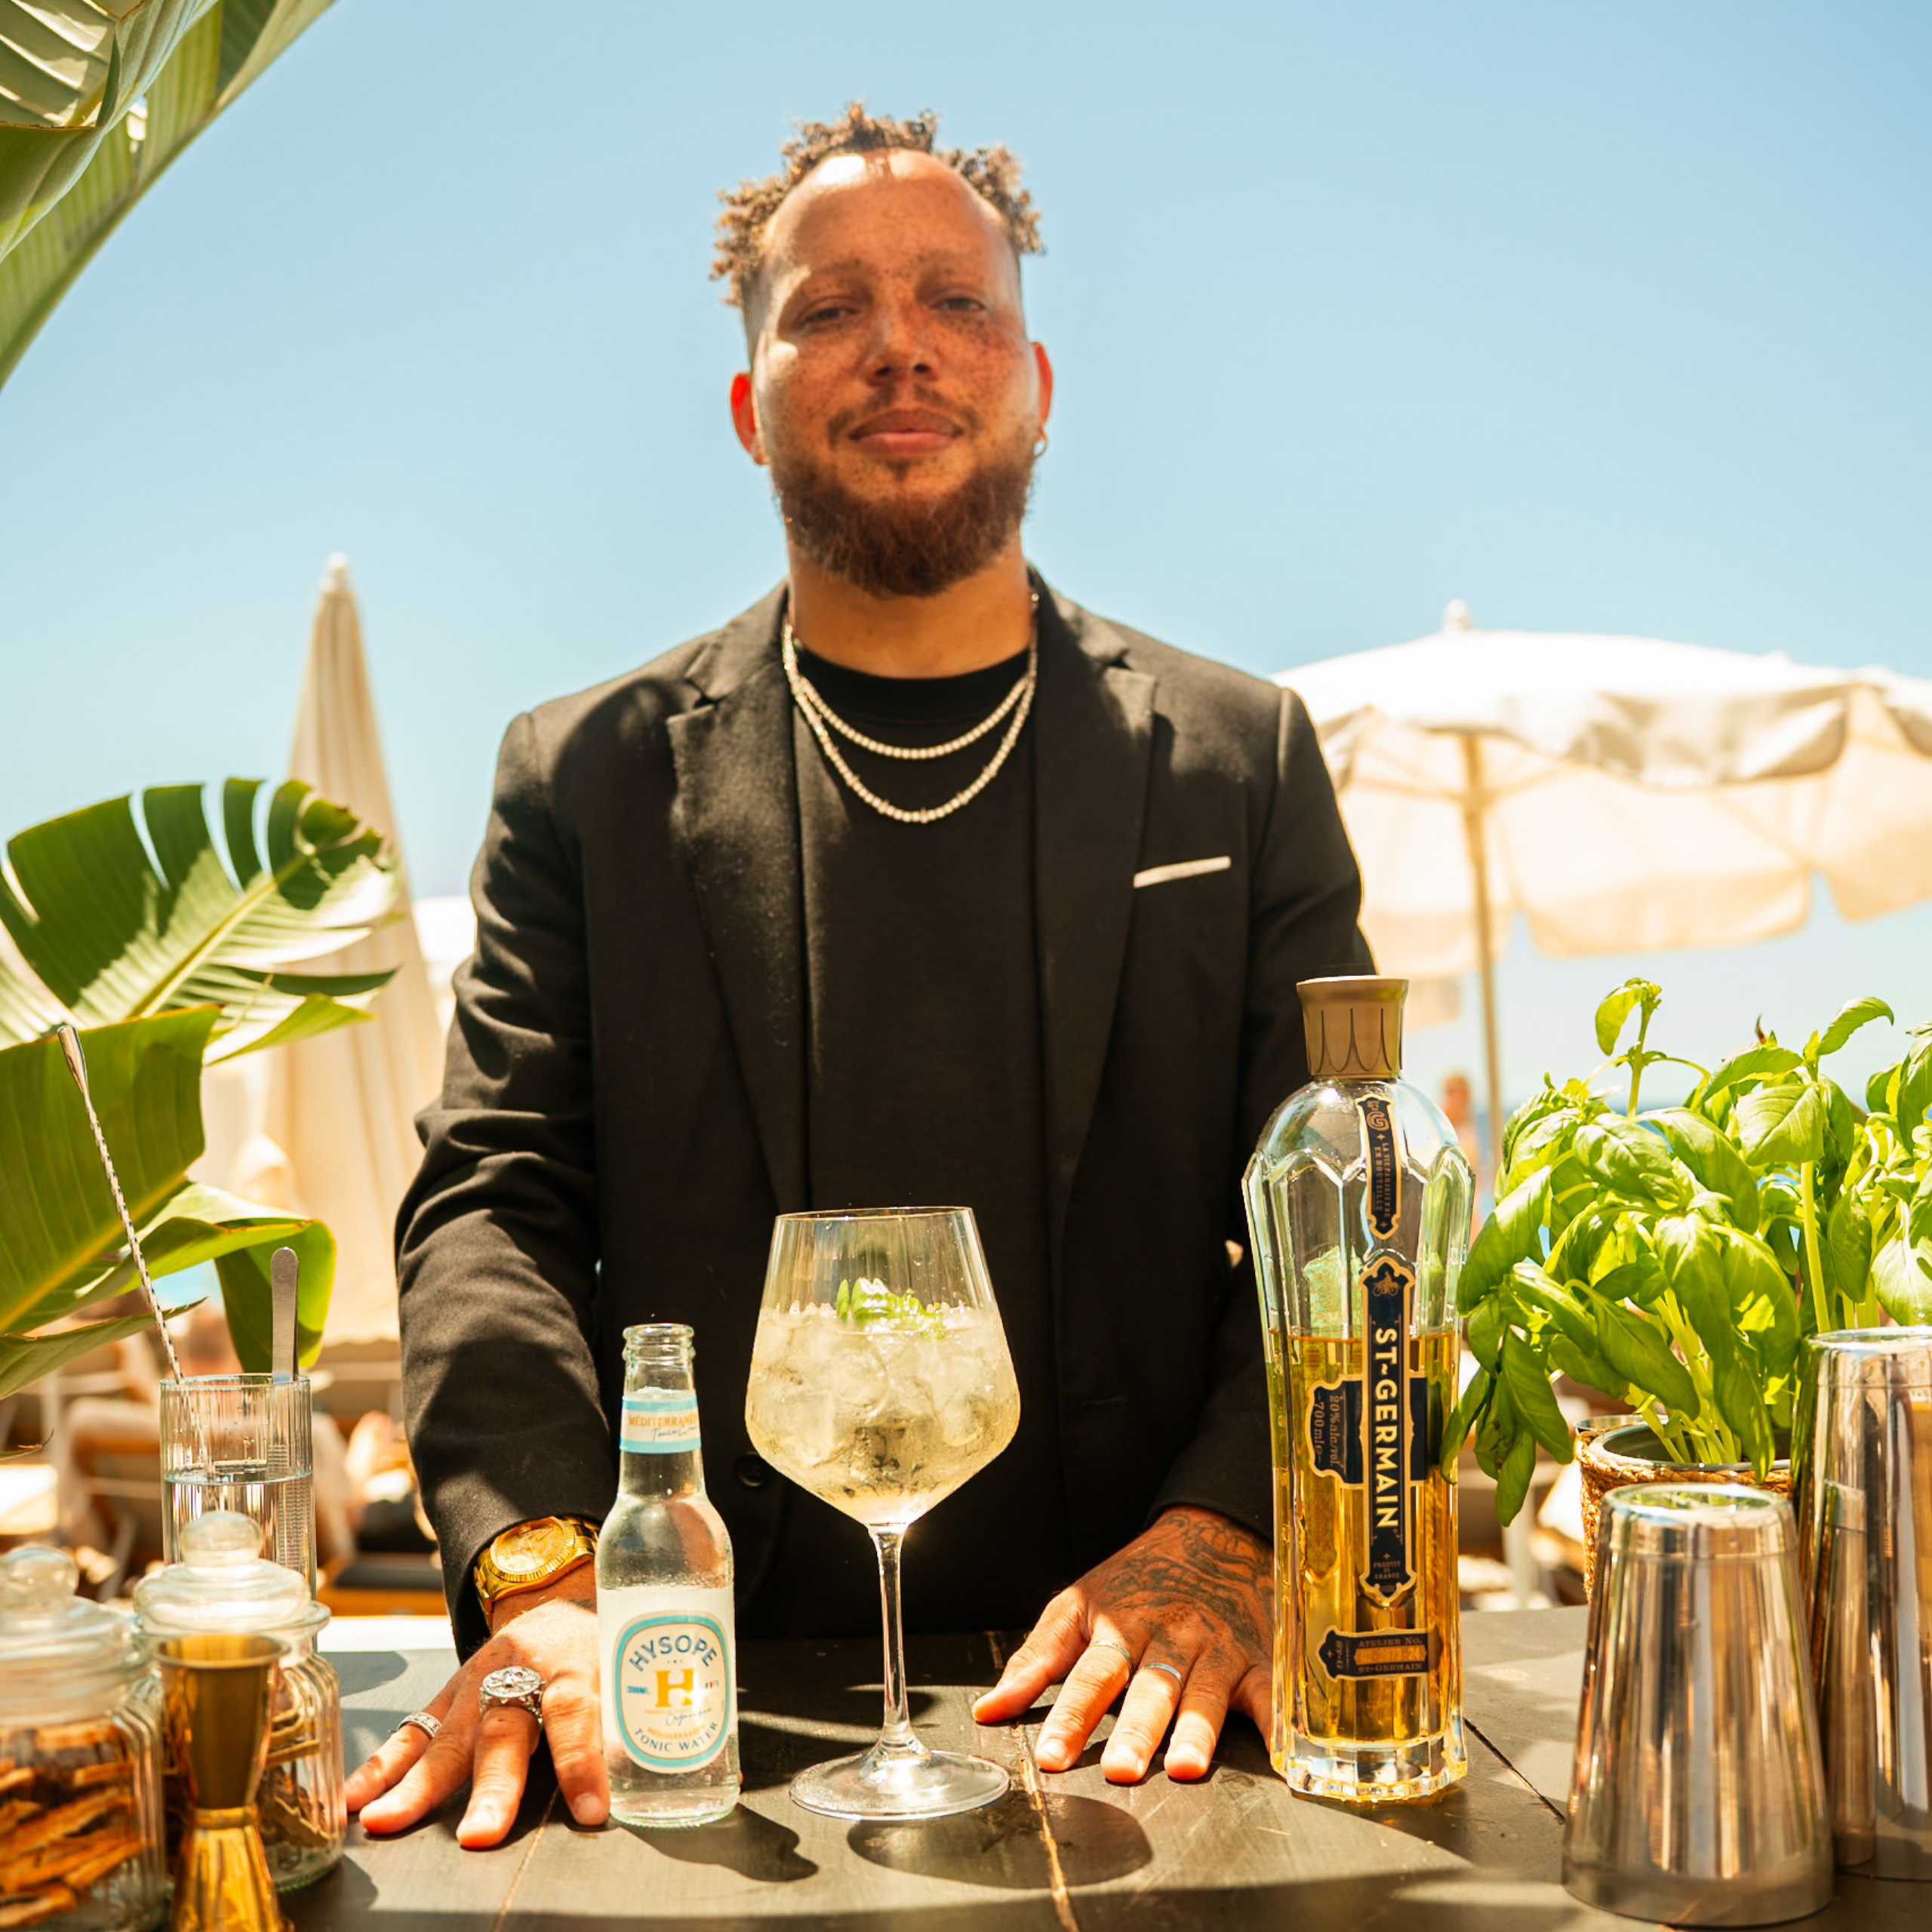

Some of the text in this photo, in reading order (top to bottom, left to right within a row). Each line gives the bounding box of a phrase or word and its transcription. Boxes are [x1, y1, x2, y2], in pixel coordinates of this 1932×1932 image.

[629, 1635, 717, 1672] HYSOPE
[1358, 1638, 1401, 1648] ATELIER
[635, 1721, 718, 1752] TONIC WATER
